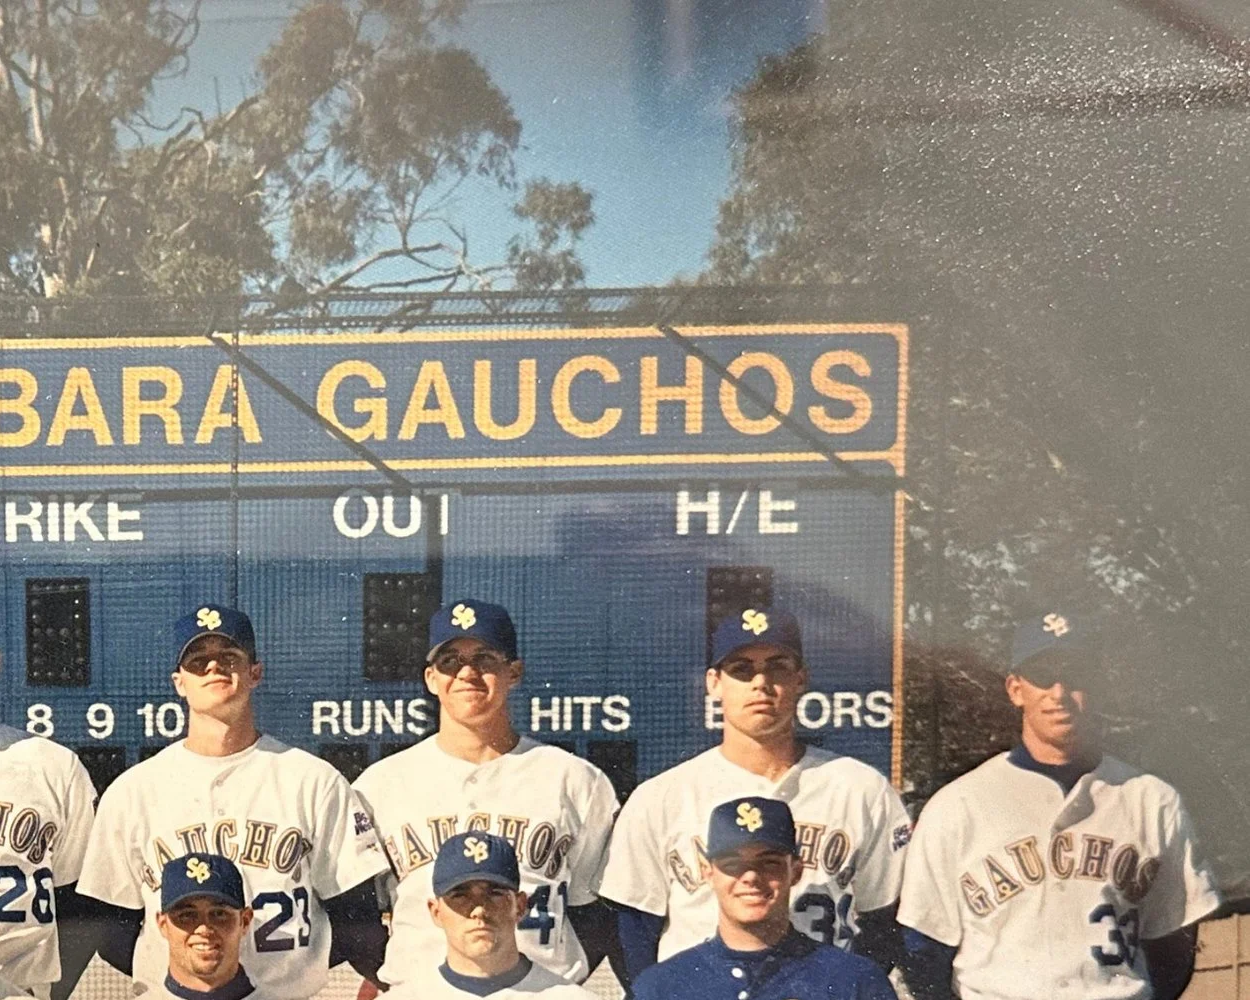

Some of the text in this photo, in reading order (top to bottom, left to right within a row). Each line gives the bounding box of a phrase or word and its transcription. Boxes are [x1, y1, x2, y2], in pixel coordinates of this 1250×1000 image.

[316, 349, 874, 444] GAUCHOS
[676, 488, 801, 536] H/E
[27, 703, 55, 738] 8
[85, 703, 115, 739] 9
[138, 702, 186, 738] 10
[312, 700, 435, 736] RUNS
[530, 695, 631, 732] HITS
[705, 690, 894, 731] EORS
[960, 833, 1161, 918] GAUCHOS
